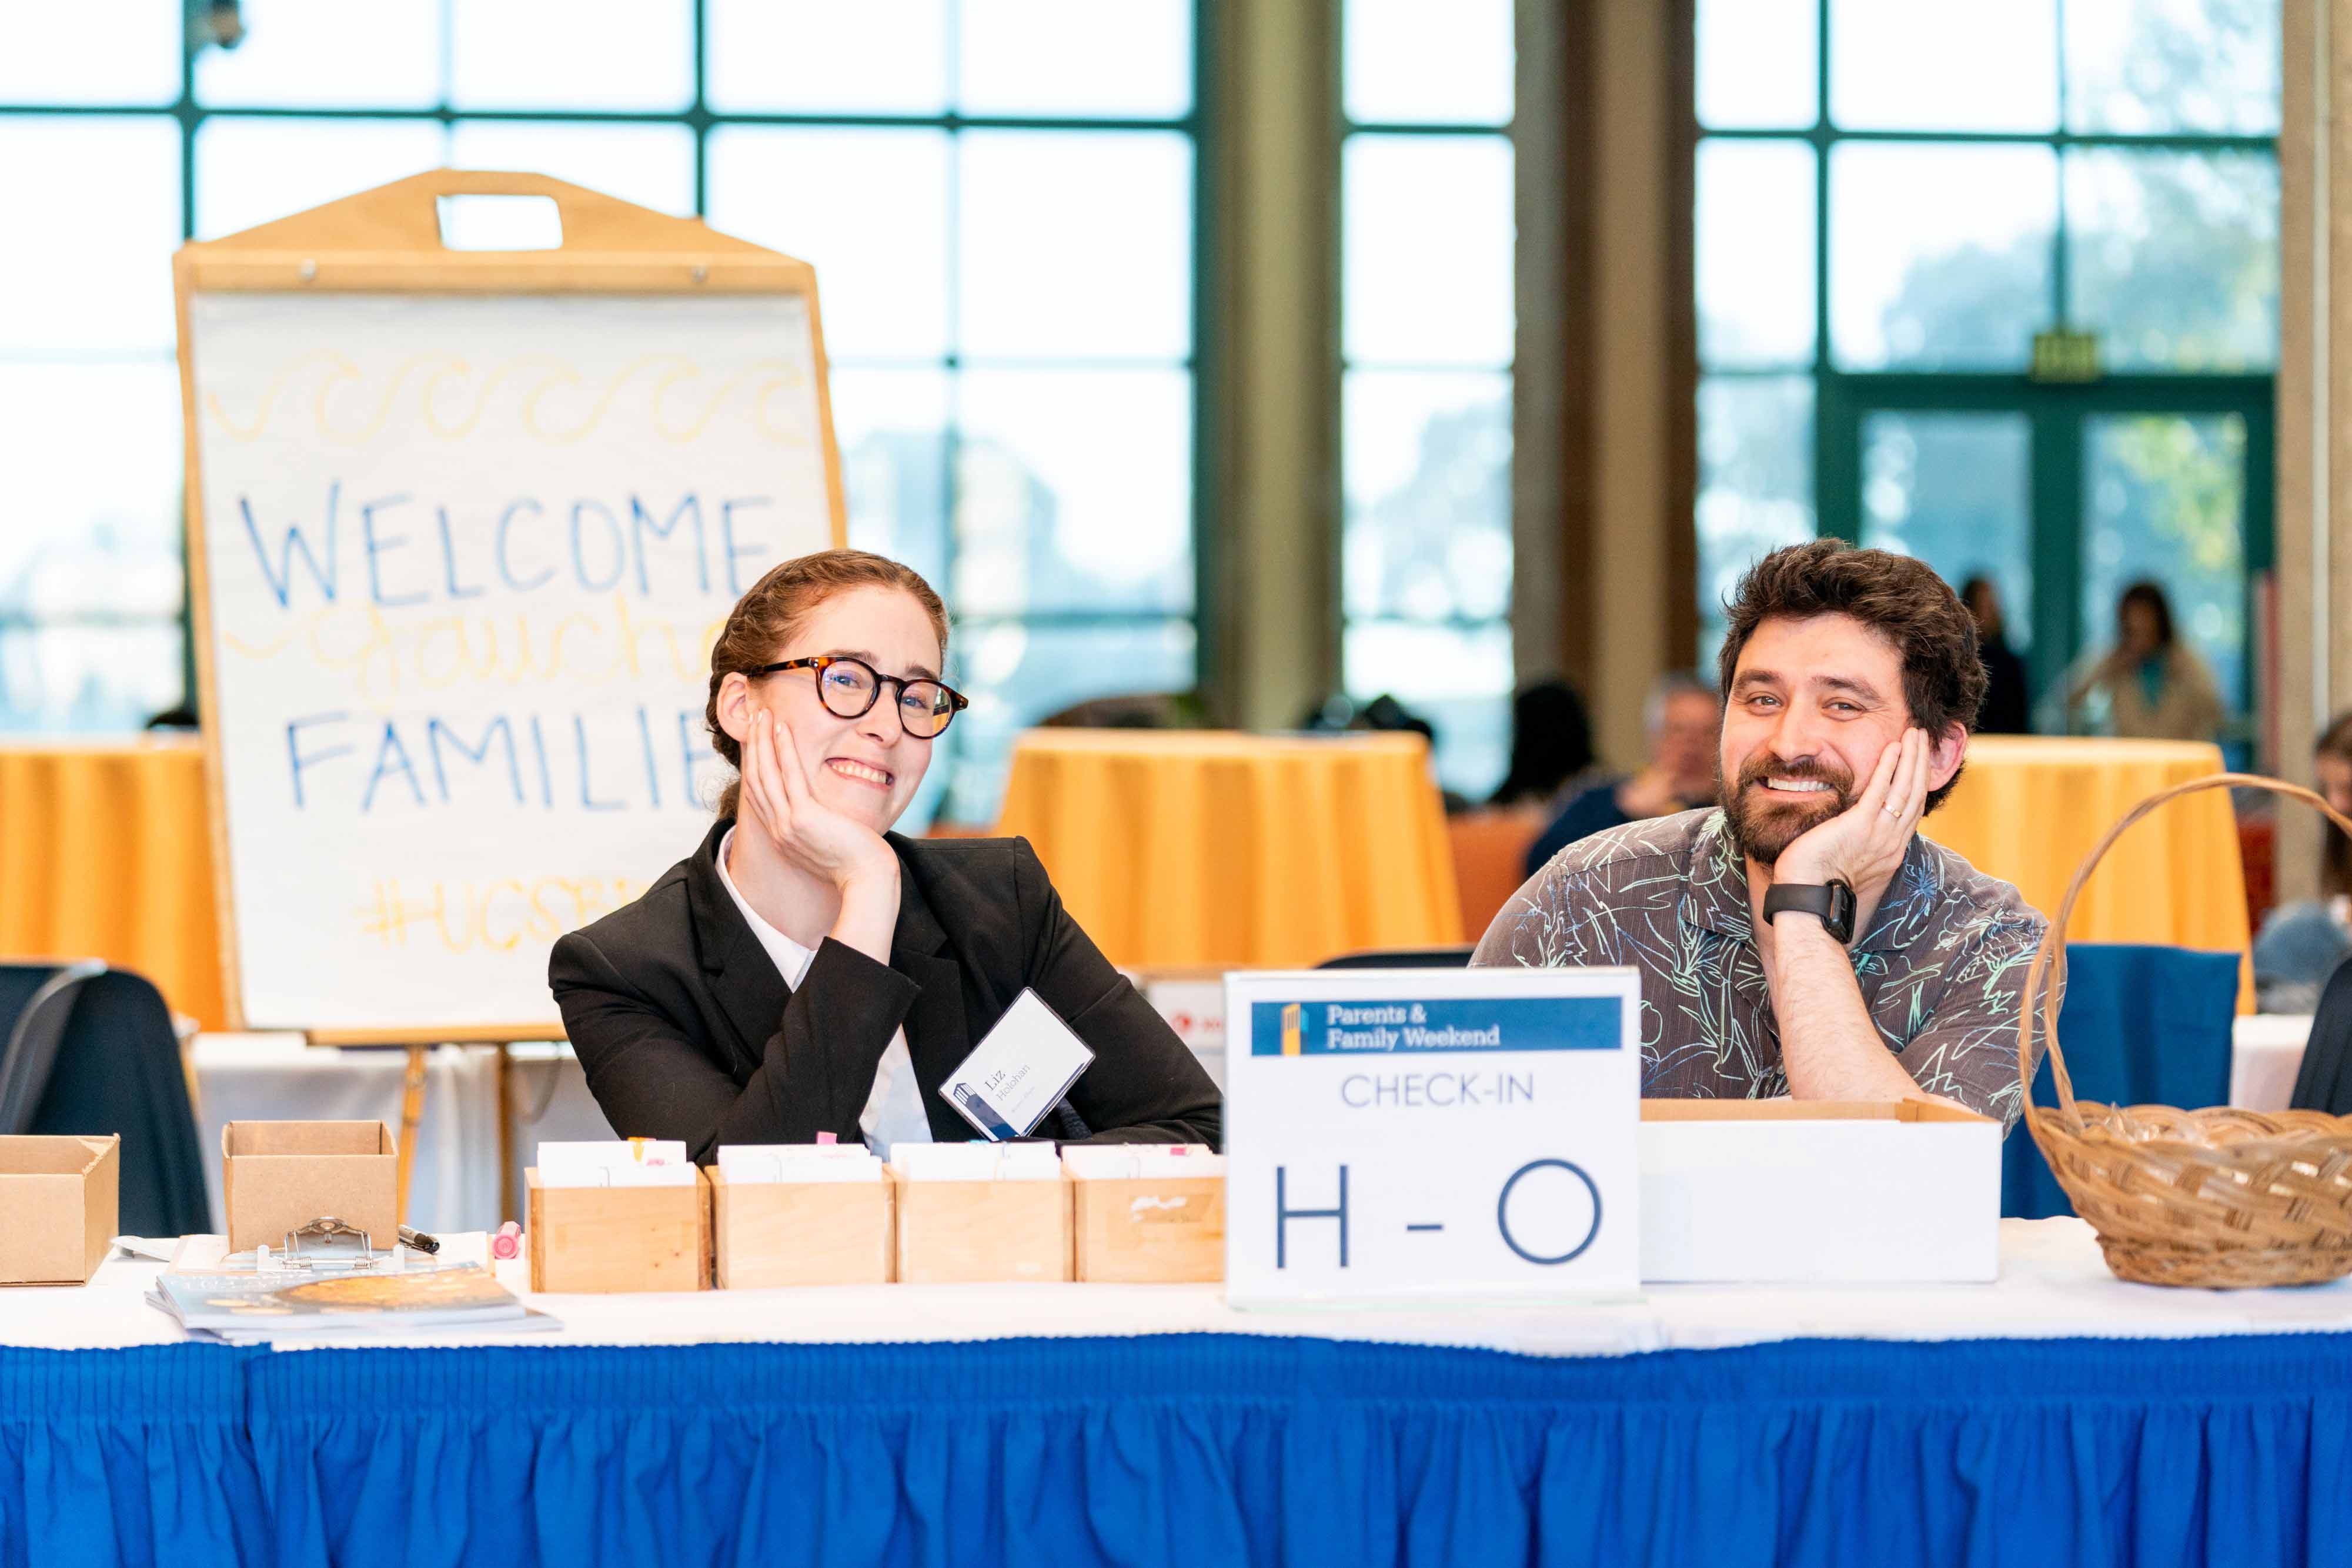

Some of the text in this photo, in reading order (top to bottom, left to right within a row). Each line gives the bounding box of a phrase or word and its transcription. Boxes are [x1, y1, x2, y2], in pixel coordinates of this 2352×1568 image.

[239, 479, 773, 611] WELCOME
[286, 705, 719, 813] FAMILIE
[1327, 1003, 1426, 1025] Parents &
[1327, 1025, 1501, 1051] Family Weekend
[984, 1069, 1006, 1091] Liz
[995, 1064, 1031, 1101] Holohan
[1341, 1072, 1534, 1108] CHECK-IN
[1276, 1158, 1602, 1269] H - O
